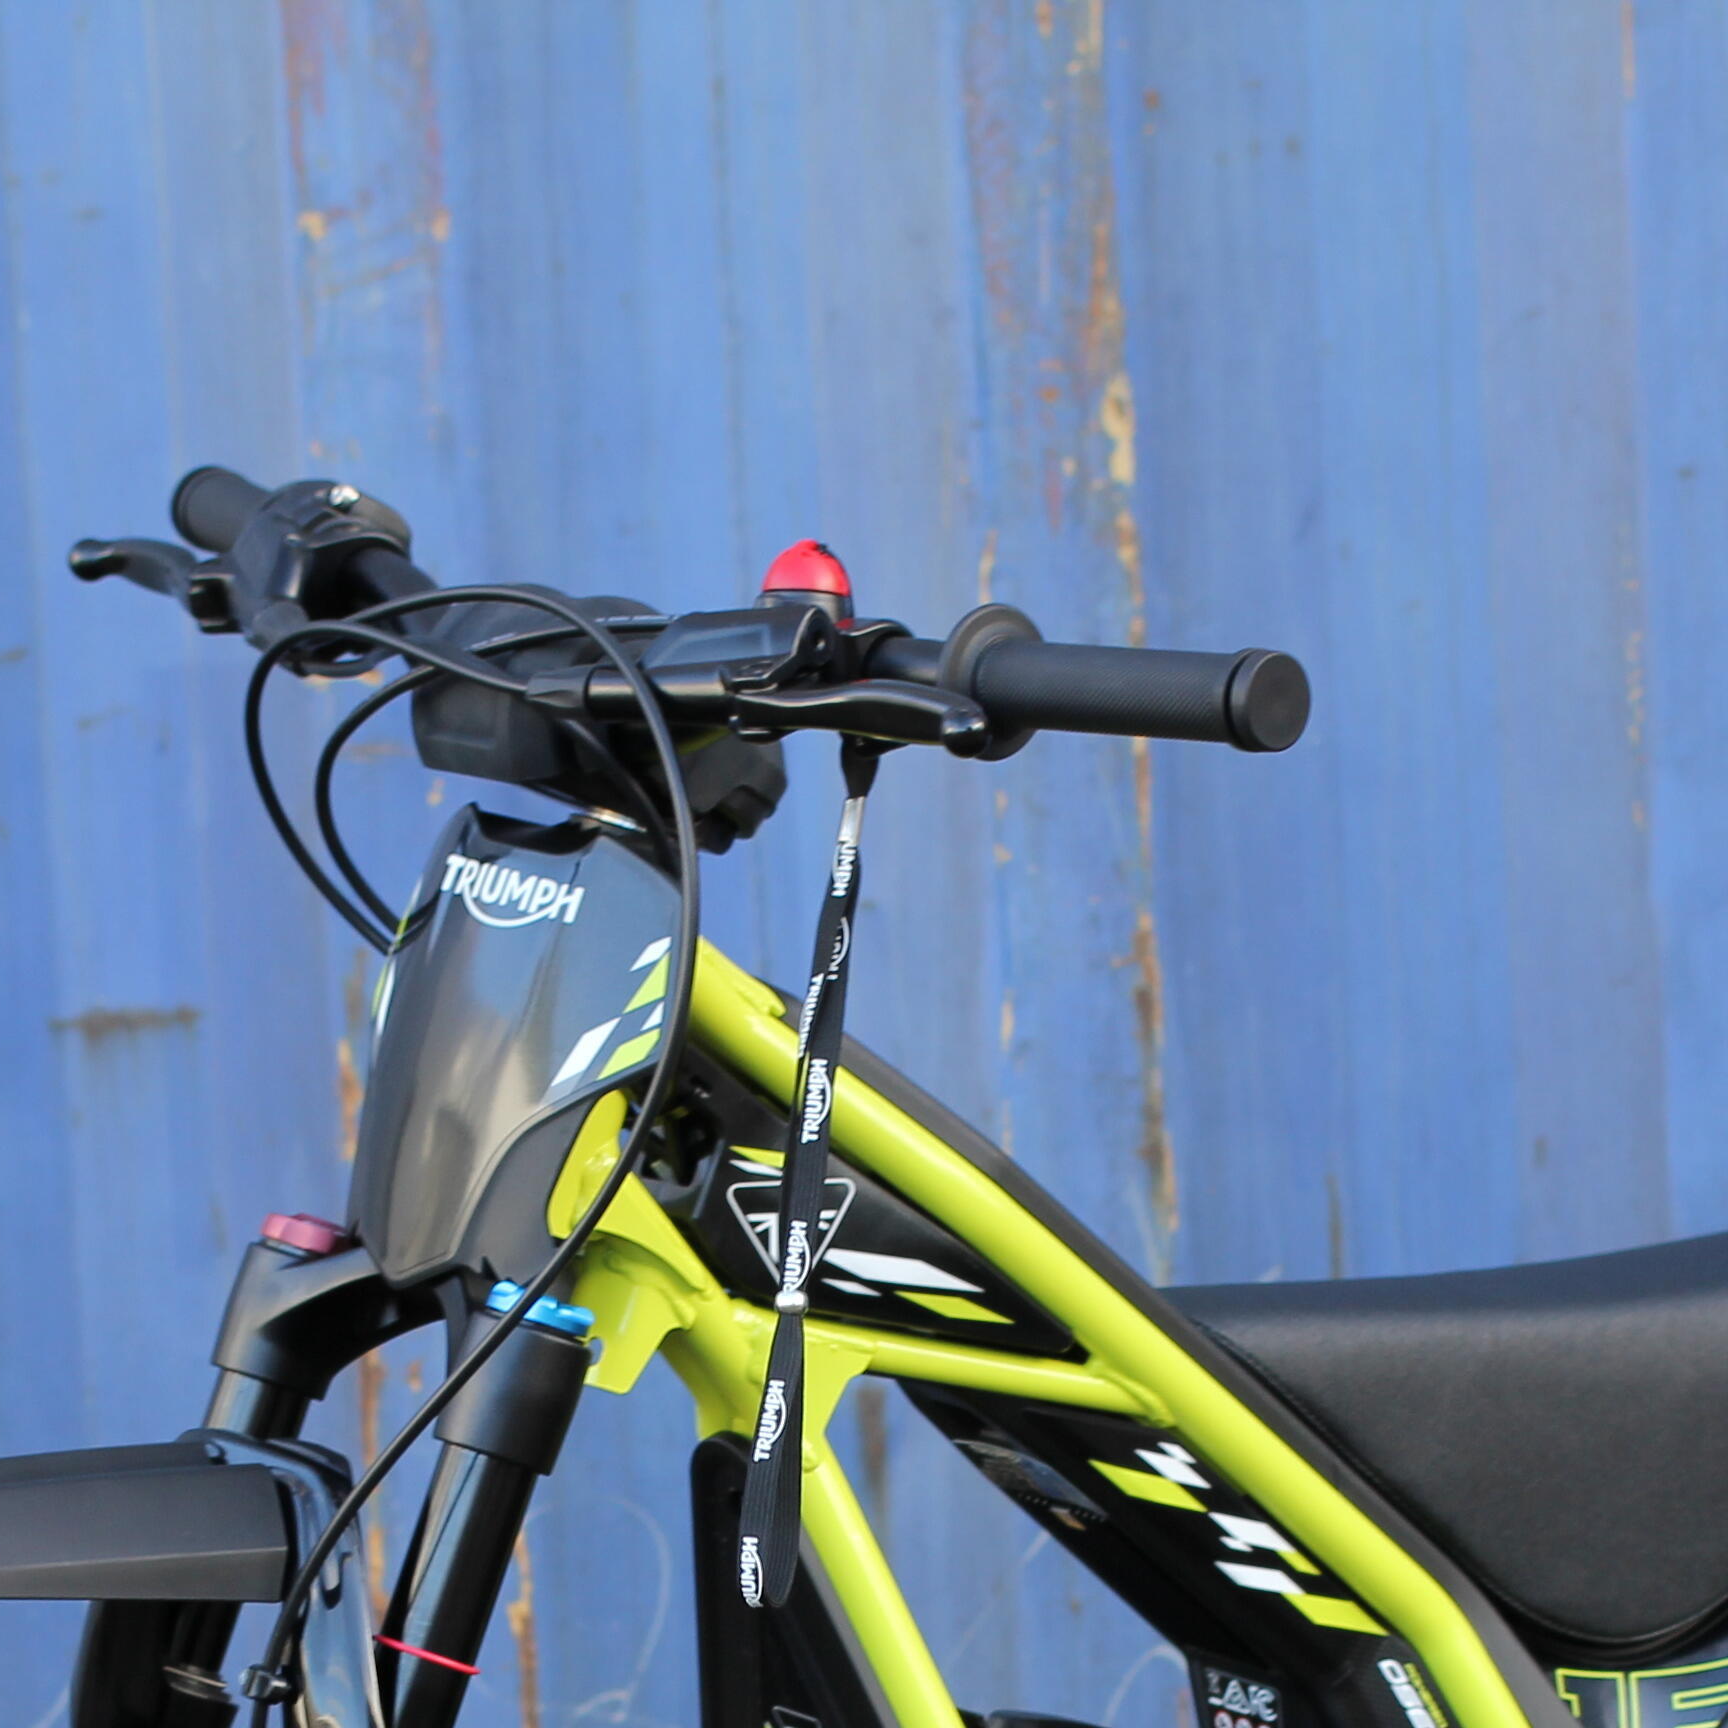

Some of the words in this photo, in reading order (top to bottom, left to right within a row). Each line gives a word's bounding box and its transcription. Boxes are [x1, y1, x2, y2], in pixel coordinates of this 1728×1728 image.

[440, 853, 586, 928] TRIUMPH
[800, 1058, 832, 1144] TRIUMPH
[783, 1219, 811, 1297] RIUMPH
[753, 1379, 787, 1463] TRIUMPH
